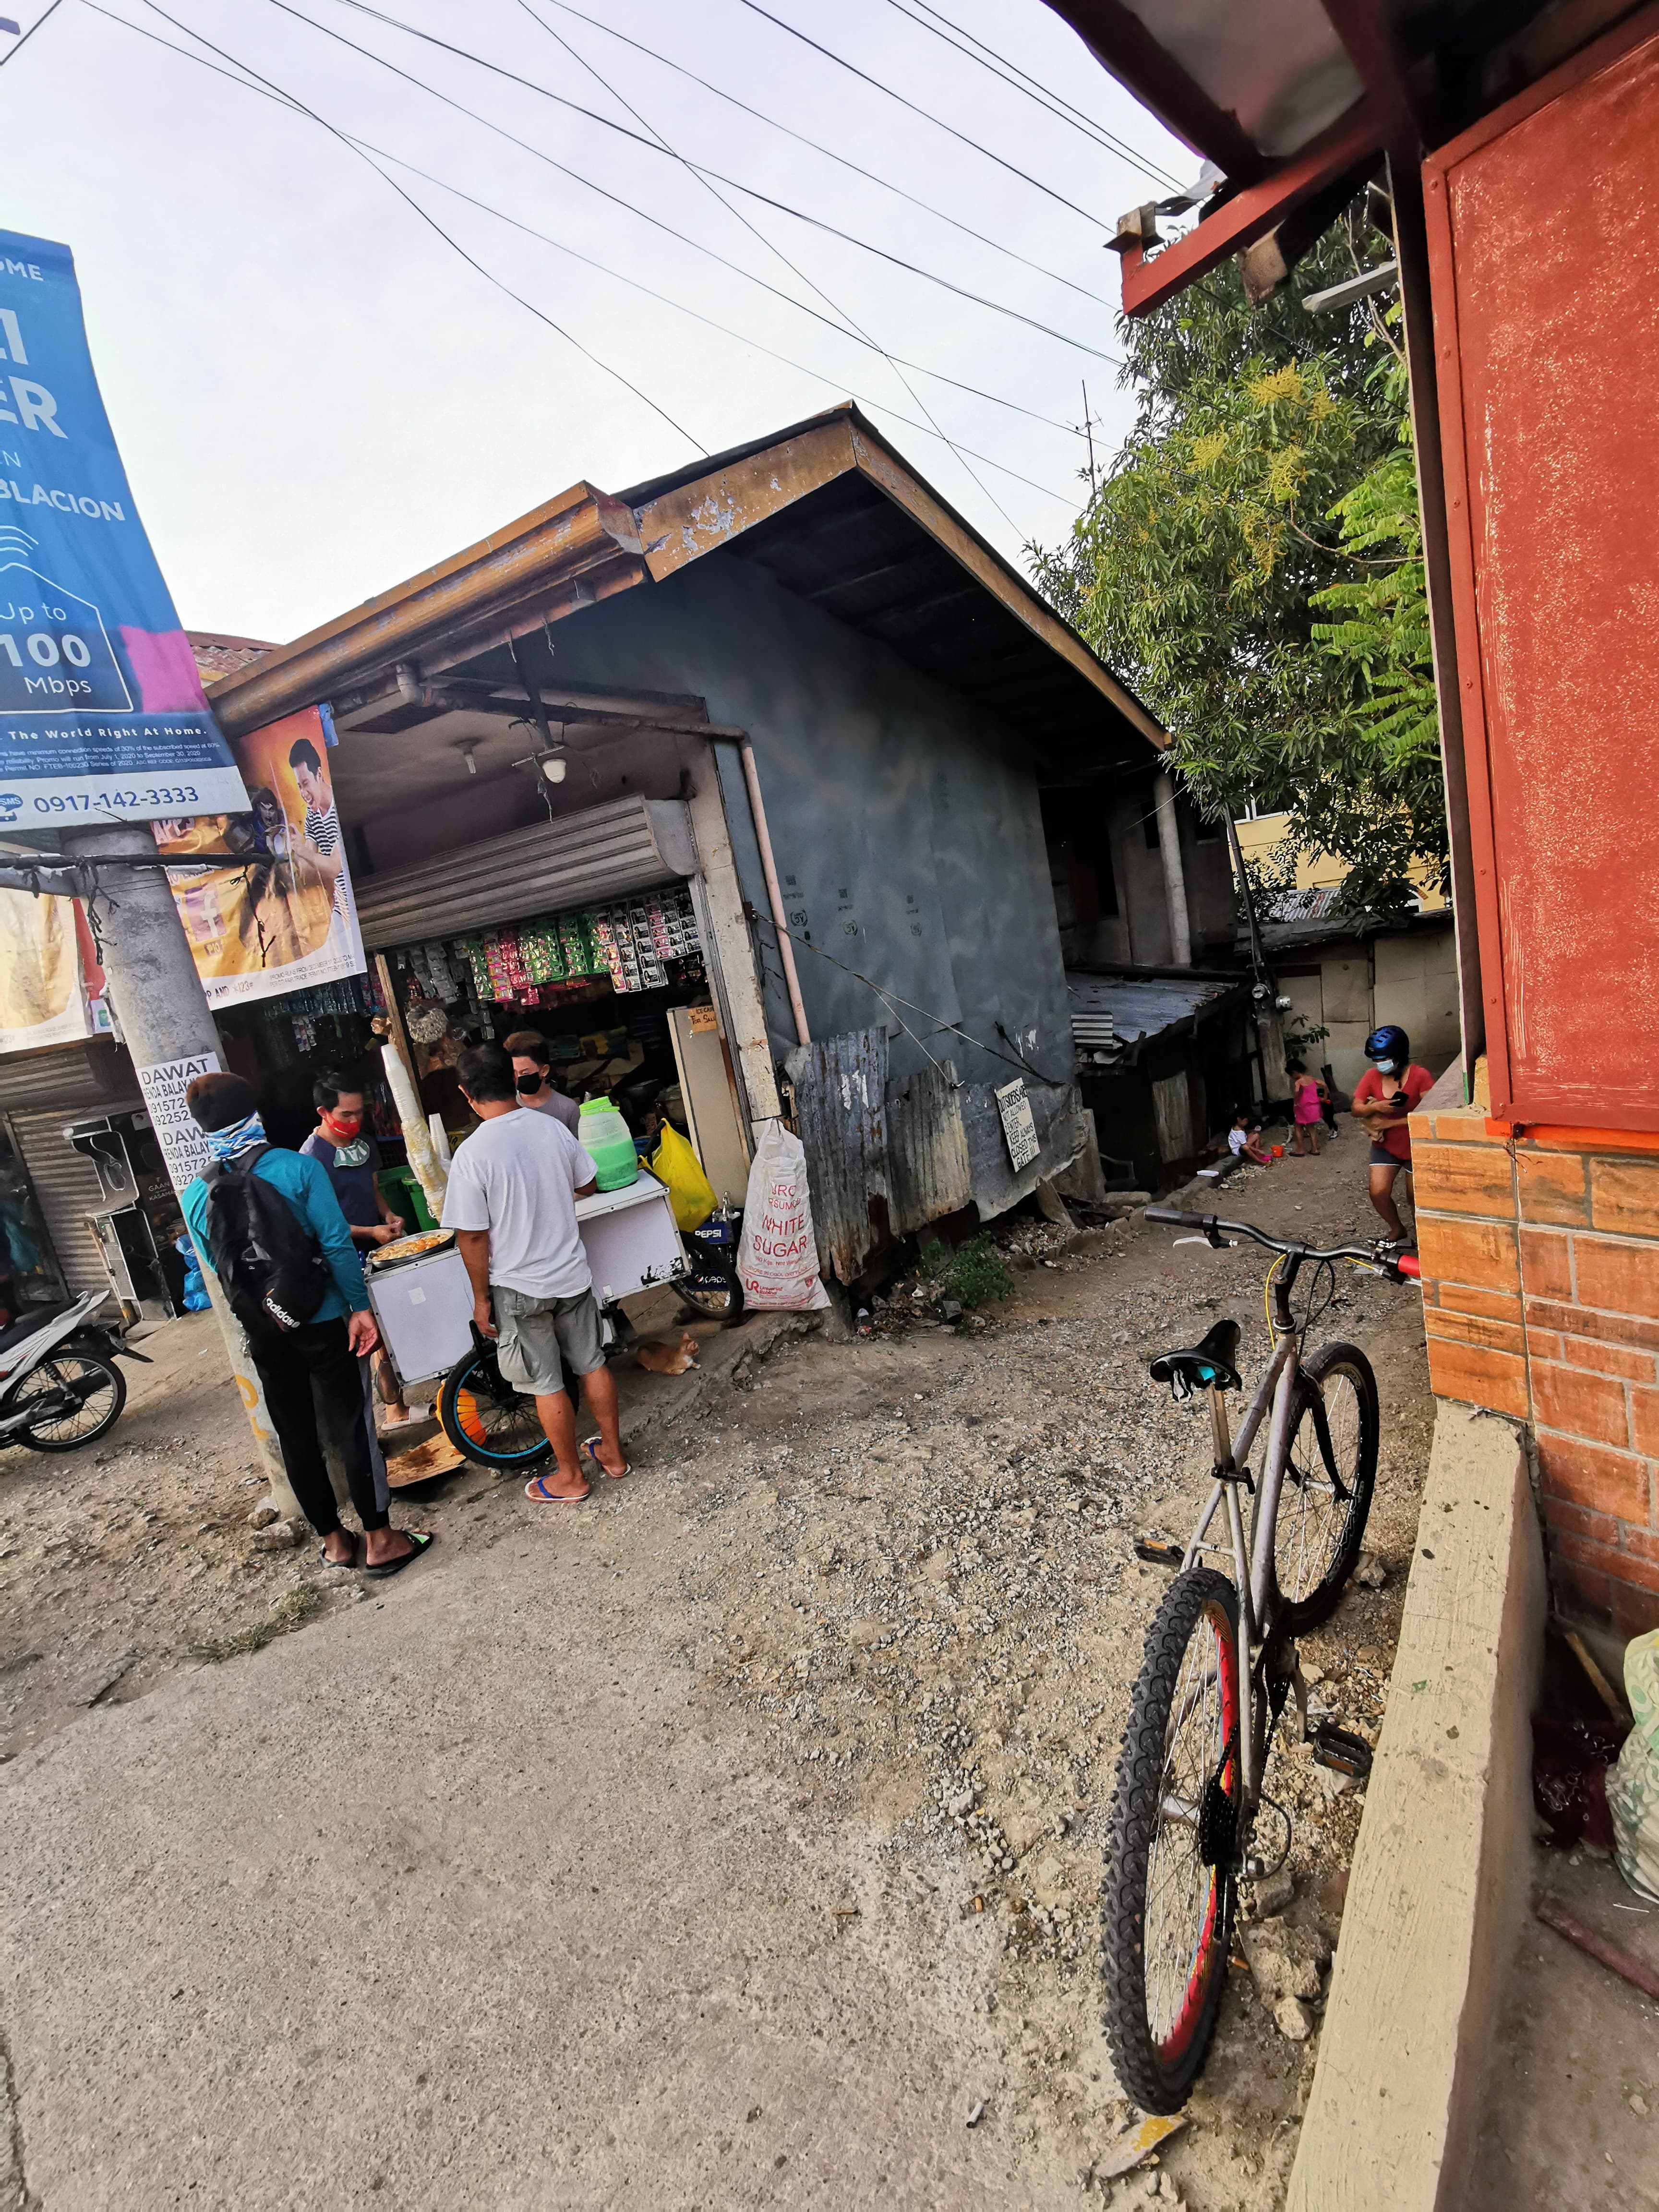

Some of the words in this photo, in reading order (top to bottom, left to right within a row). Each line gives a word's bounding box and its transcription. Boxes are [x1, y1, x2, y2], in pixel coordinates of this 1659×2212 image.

[41, 602, 67, 621] to
[0, 633, 91, 667] 100
[24, 676, 92, 697] Mbps
[8, 731, 39, 740] The
[45, 728, 92, 739] World
[98, 728, 138, 738] Right
[144, 727, 159, 736] At
[34, 786, 199, 813] 0917-142-3333
[215, 985, 230, 999] AND
[142, 1058, 208, 1085] DAWAT
[161, 1079, 188, 1097] BALAY
[184, 1140, 210, 1158] BALAY
[1011, 1139, 1028, 1159] CLOSED
[753, 1235, 807, 1258] SUGAR
[266, 1297, 295, 1326] adidas
